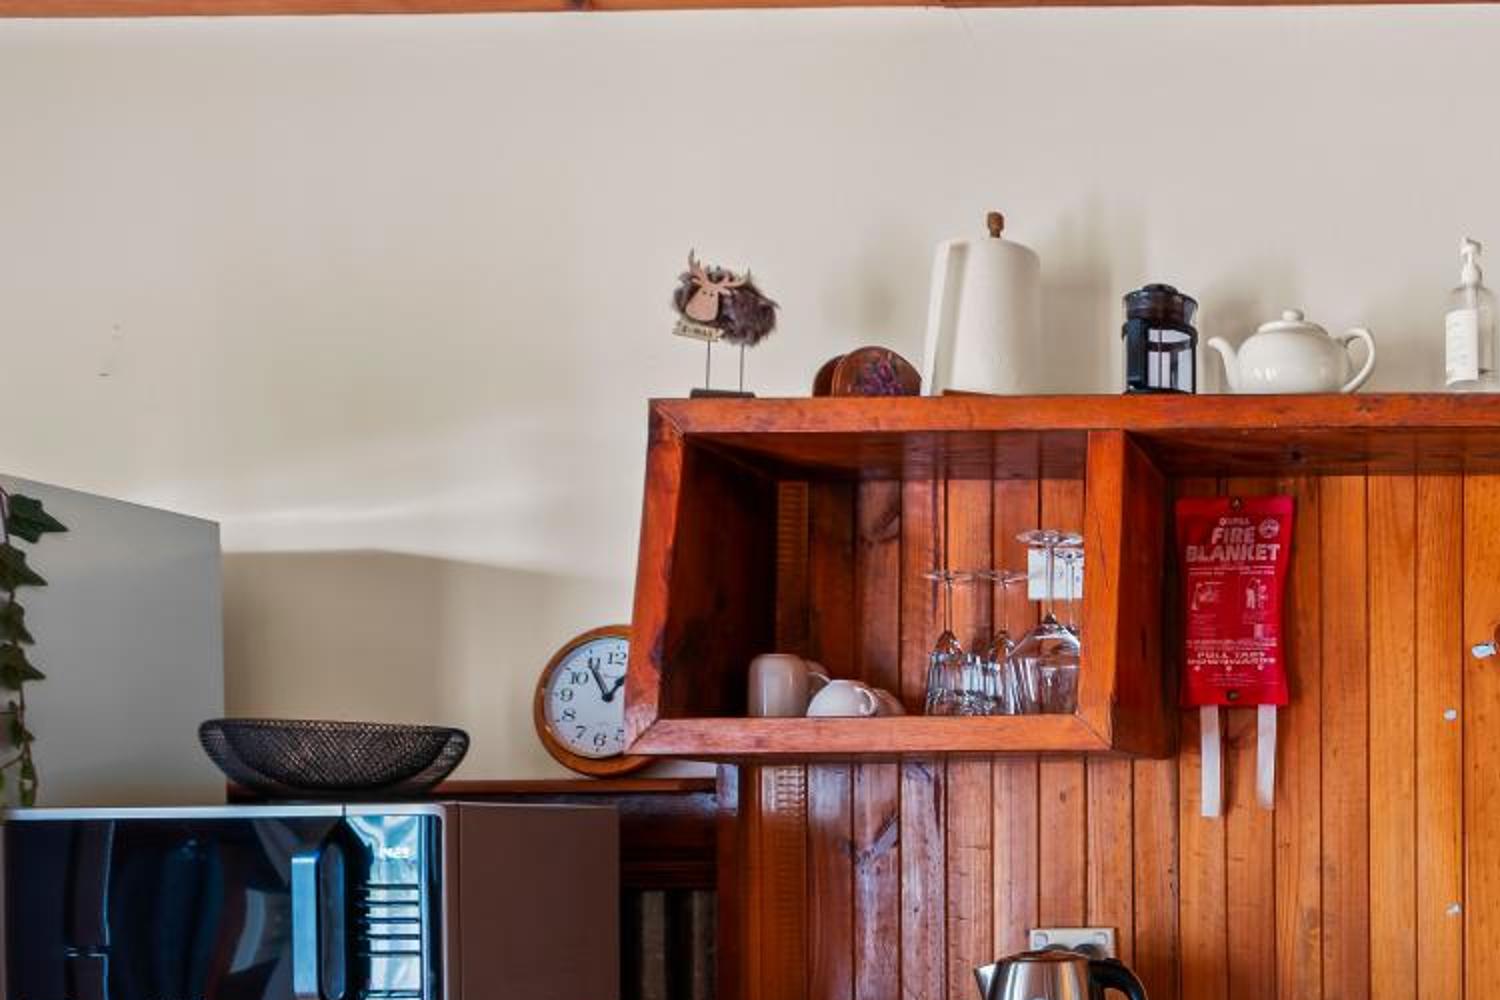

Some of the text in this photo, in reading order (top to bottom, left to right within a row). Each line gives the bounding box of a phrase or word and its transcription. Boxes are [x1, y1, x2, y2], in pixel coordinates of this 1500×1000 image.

[1211, 526, 1256, 544] FIRE
[1186, 543, 1281, 562] BLANKET
[607, 651, 626, 666] 12
[570, 671, 588, 685] 10
[560, 688, 573, 702] 9
[561, 708, 576, 721] 8
[575, 725, 587, 740] 7
[593, 732, 607, 747] 6
